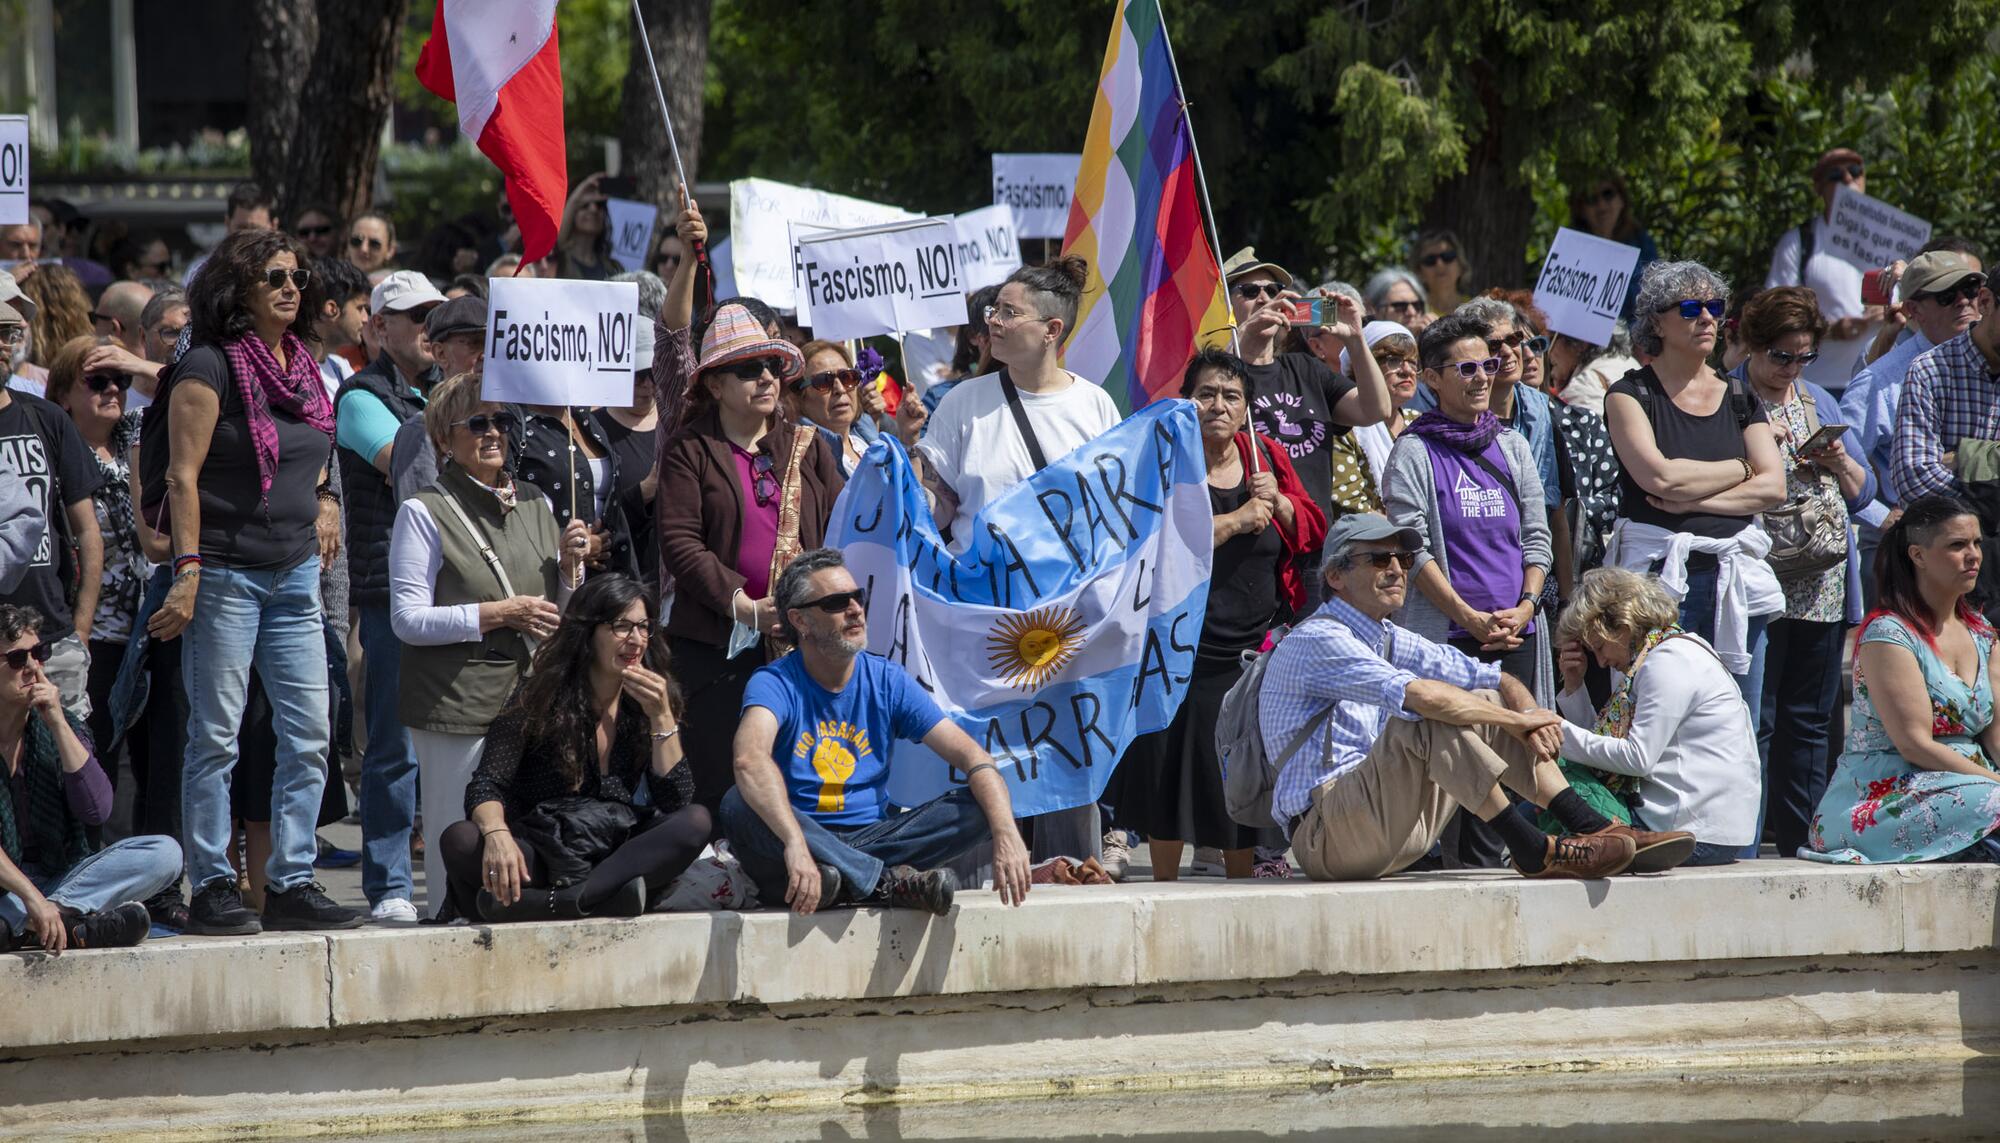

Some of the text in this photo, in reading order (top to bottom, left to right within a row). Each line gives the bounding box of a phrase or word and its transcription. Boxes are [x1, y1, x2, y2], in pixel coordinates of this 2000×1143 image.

[0, 143, 23, 188] O!
[1836, 211, 1858, 234] Diga
[1872, 232, 1894, 249] que
[806, 255, 914, 307] Fascismo,
[917, 242, 958, 292] NO!
[1538, 252, 1629, 314] Fascismo, NO!
[490, 309, 633, 373] Fascismo, NO!
[1254, 392, 1304, 409] MI VOZ
[1460, 488, 1504, 502] DANGER!
[1461, 505, 1506, 518] THE LINE
